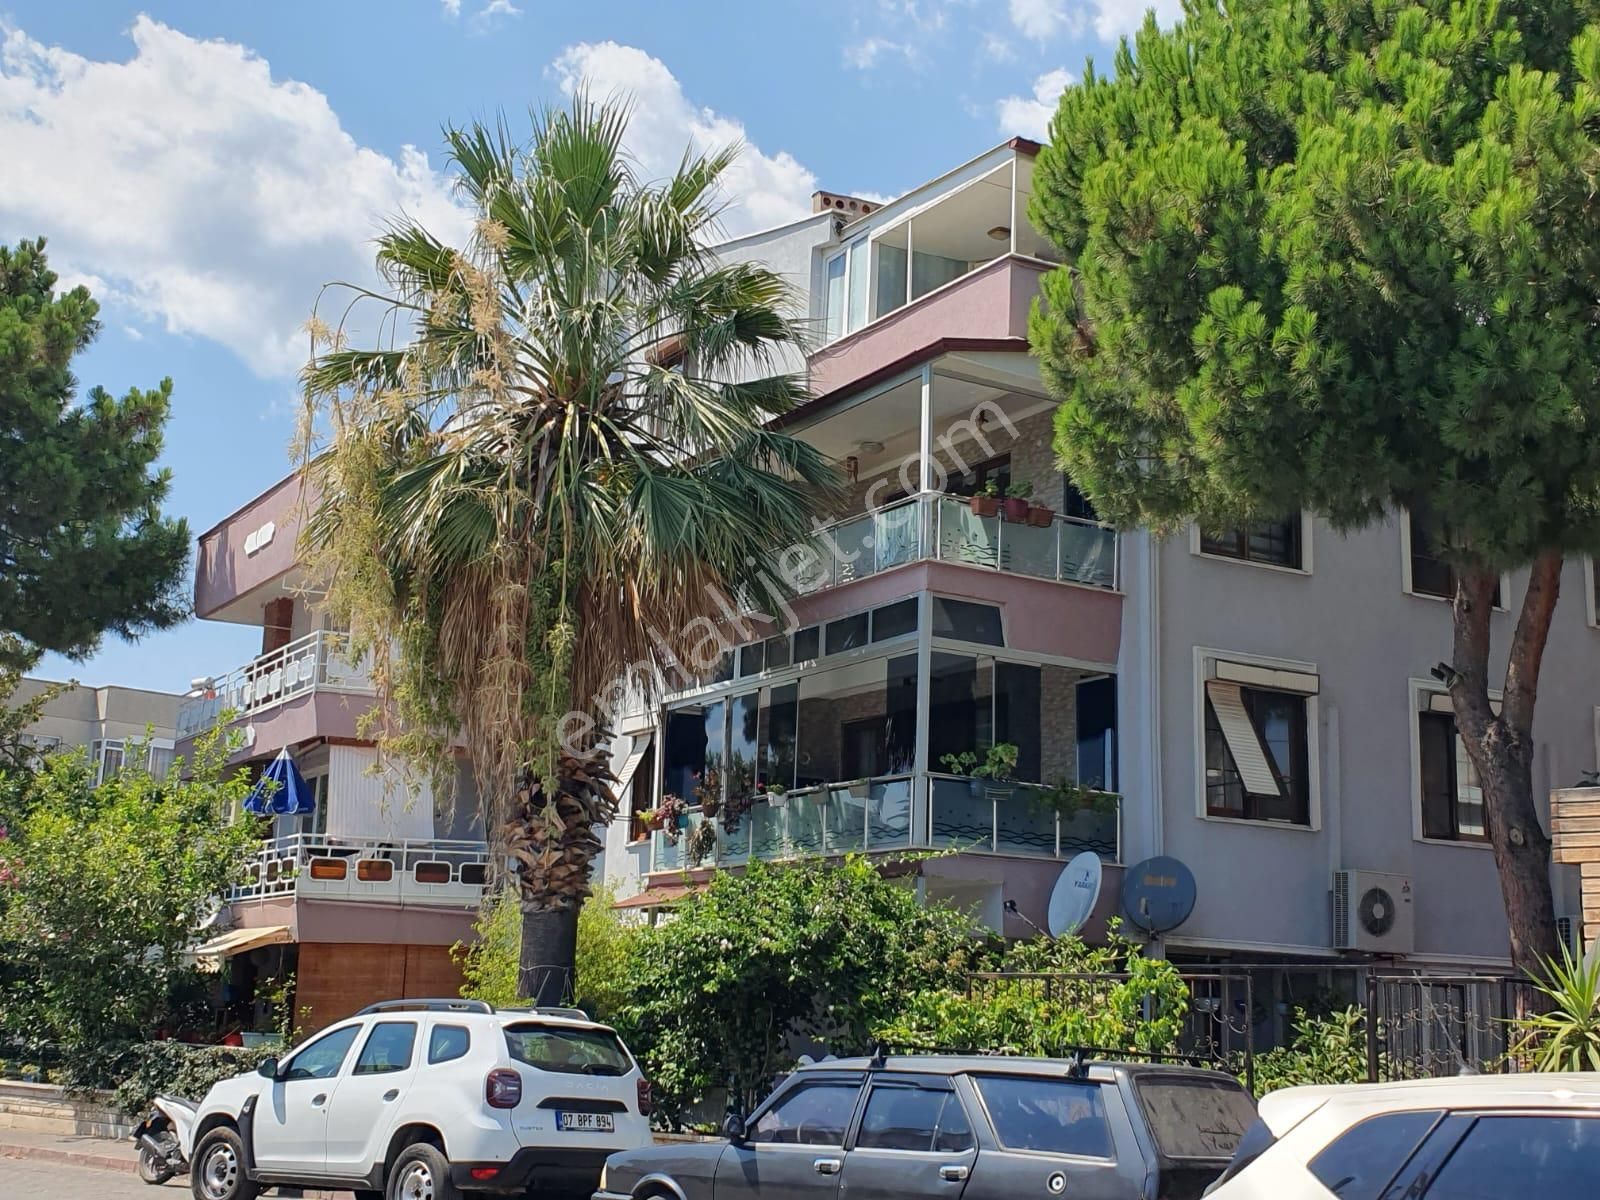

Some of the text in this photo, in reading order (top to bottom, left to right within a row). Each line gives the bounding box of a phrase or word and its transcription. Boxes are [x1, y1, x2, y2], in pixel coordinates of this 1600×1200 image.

[562, 1114, 611, 1128] 07 BPF 894
